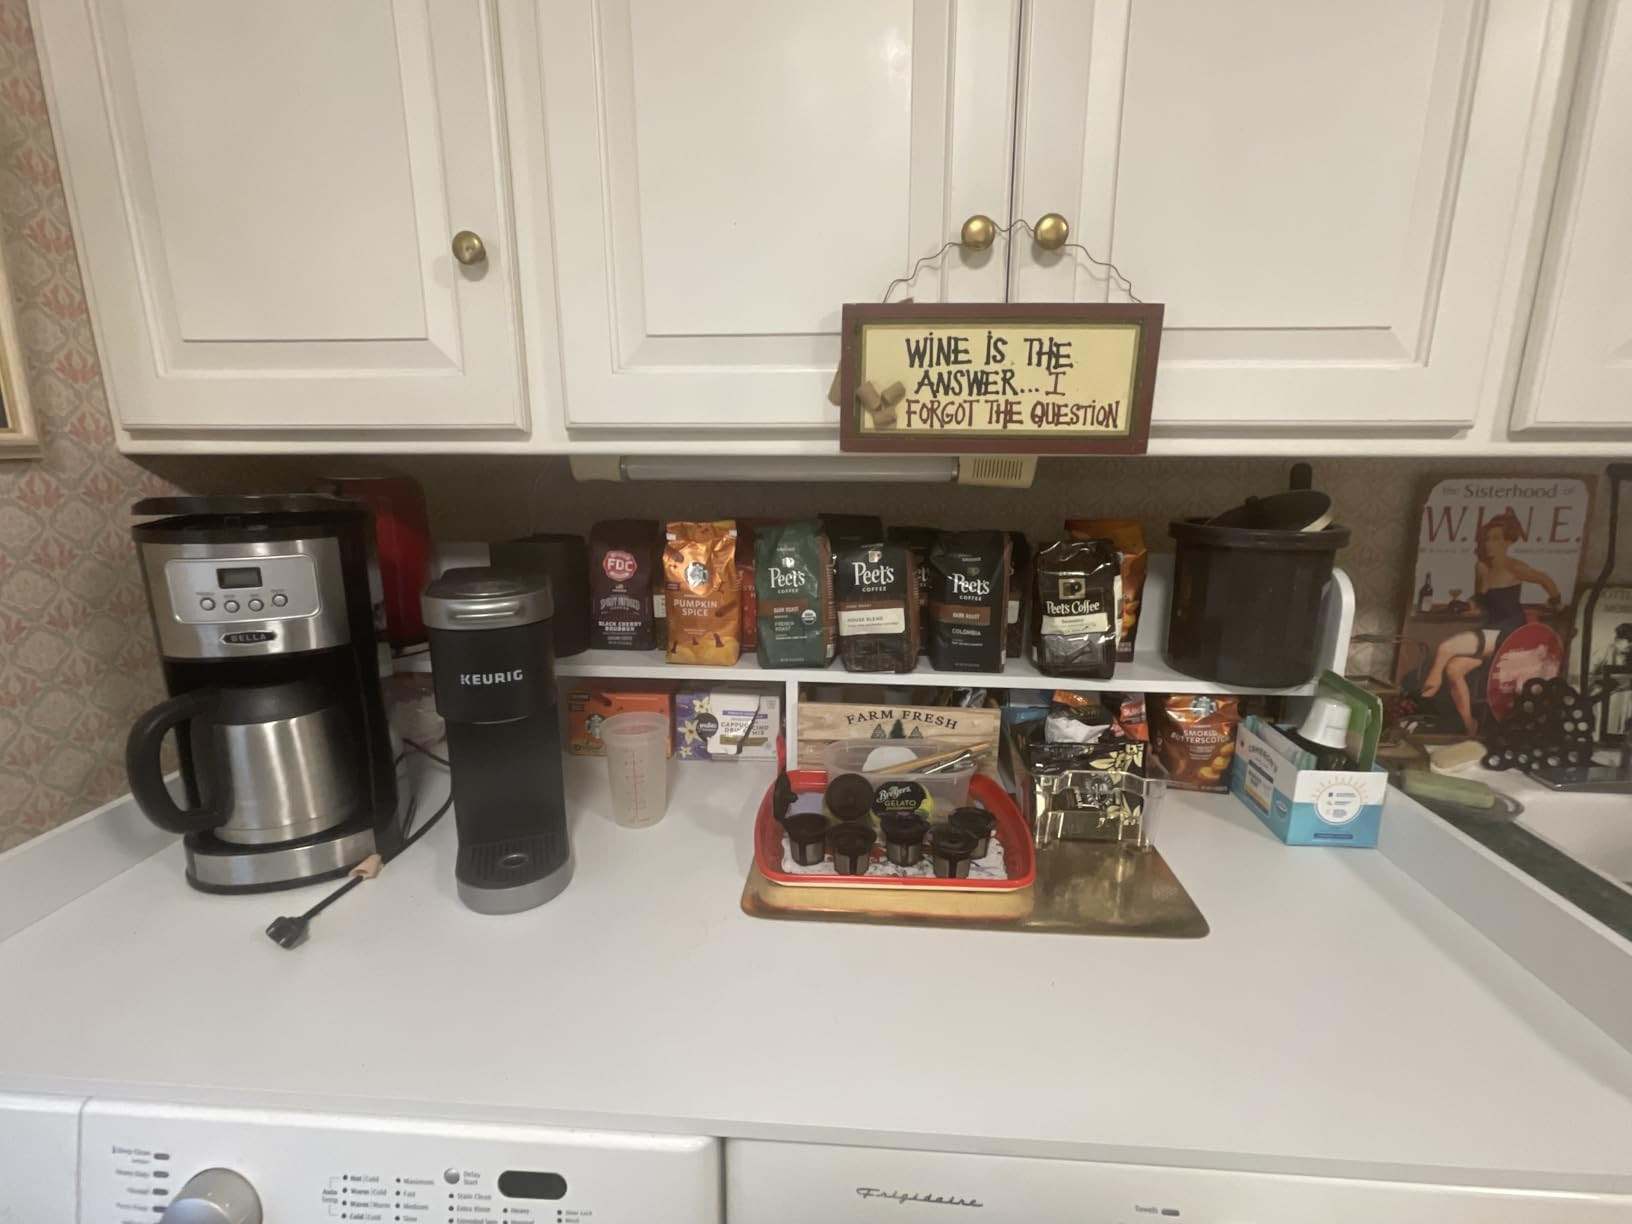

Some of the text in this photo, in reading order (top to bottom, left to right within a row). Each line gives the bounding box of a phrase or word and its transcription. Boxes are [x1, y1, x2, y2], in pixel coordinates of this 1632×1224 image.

[905, 330, 1074, 370] WINE IS THE
[914, 369, 1067, 399] ANSWER... I
[905, 398, 1121, 429] FORGOT THE QUESTION
[1463, 483, 1559, 499] Sisterhood
[607, 558, 634, 572] FDC
[767, 567, 806, 589] Peet's
[851, 561, 895, 586] Peet's
[951, 572, 991, 596] Peet's
[673, 598, 718, 609] PUMPKIN
[959, 594, 983, 602] COFFEE
[681, 607, 709, 617] SPICE
[1071, 599, 1100, 614] Coffee
[229, 632, 267, 642] BELLA
[951, 628, 982, 636] COLOMBIA
[459, 669, 524, 686] KEURIG
[846, 709, 959, 730] FARM FRESH
[884, 799, 917, 807] GELATO
[855, 1187, 984, 1208] Frigidaire
